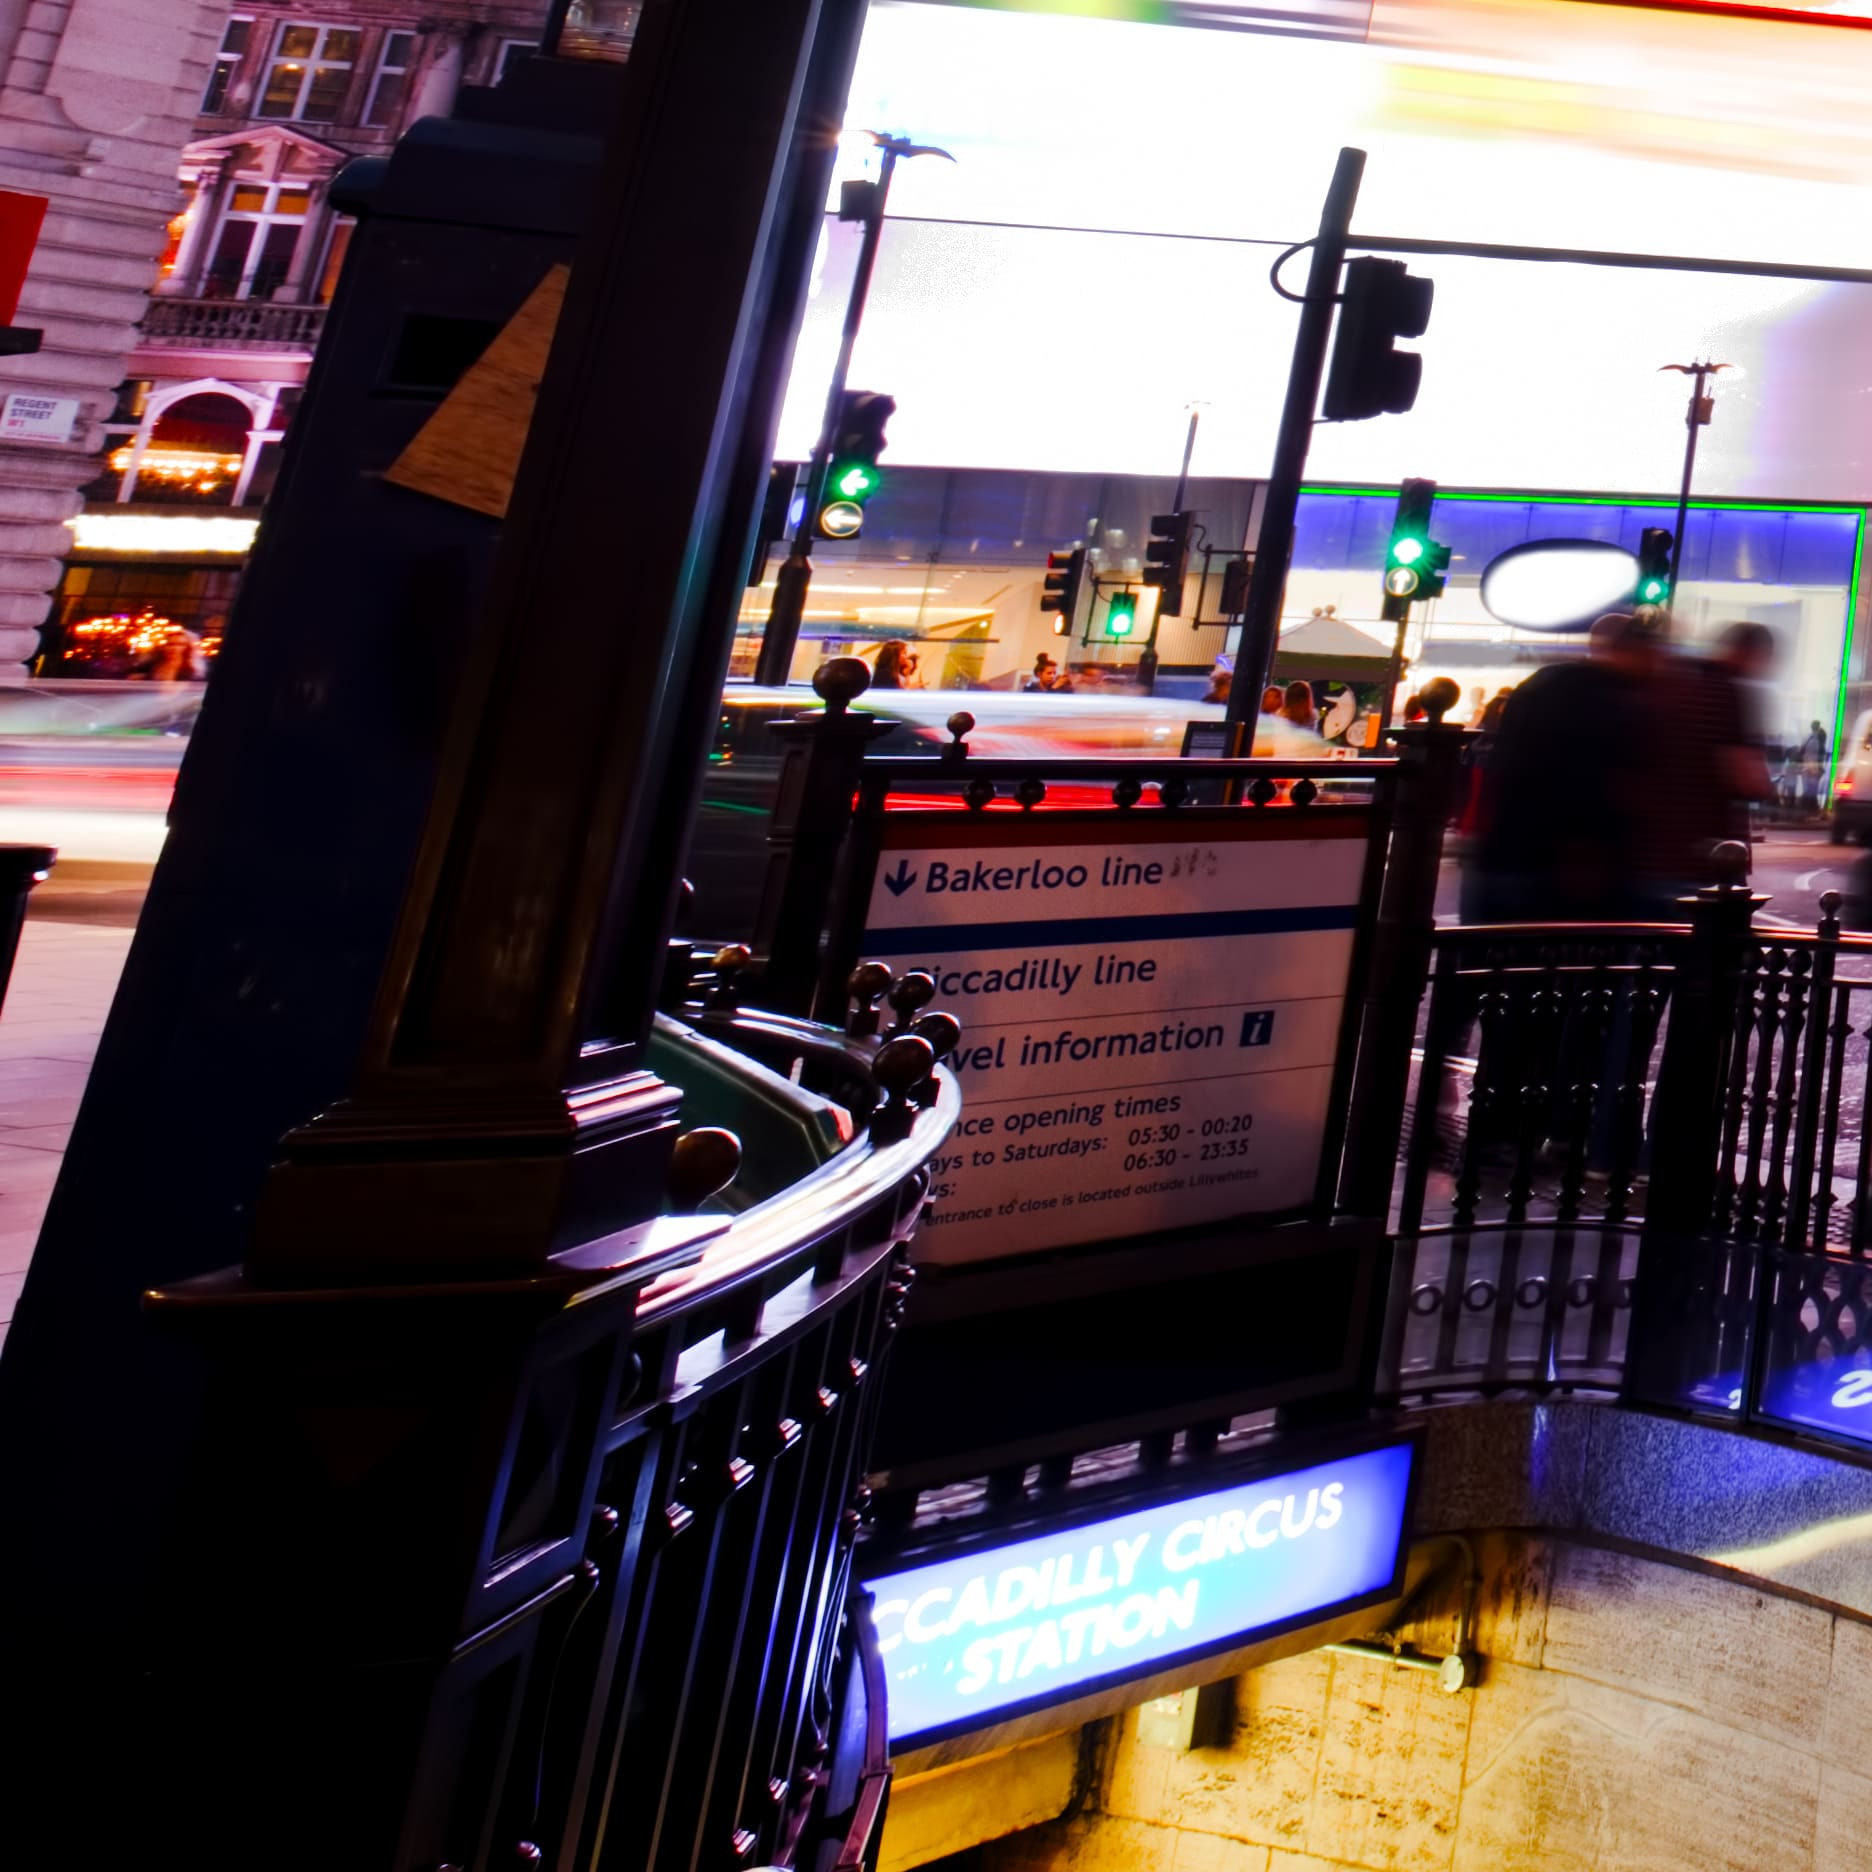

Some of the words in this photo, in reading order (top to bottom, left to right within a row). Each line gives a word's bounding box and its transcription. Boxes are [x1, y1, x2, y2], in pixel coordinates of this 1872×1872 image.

[925, 859, 1088, 893] Bakerloo
[1101, 856, 1163, 887] line
[1094, 954, 1157, 986] line
[944, 1037, 1005, 1072] vel
[1020, 1020, 1225, 1066] information
[1004, 1102, 1106, 1136] opening
[1114, 1095, 1181, 1118] times
[972, 1150, 995, 1167] to
[1002, 1137, 1109, 1163] Saturdays:
[1128, 1123, 1181, 1147] 05:30
[1200, 1113, 1253, 1137] 00:20
[1123, 1149, 1177, 1172] 06:30
[1199, 1138, 1249, 1161] 23:35
[1019, 1196, 1058, 1212] close
[1062, 1193, 1073, 1206] is
[1078, 1184, 1131, 1203] located
[1134, 1178, 1185, 1194] outside
[871, 1531, 1151, 1653] CCADILLY
[1161, 1480, 1344, 1574] CIRCUS
[955, 1577, 1201, 1696] STATION
